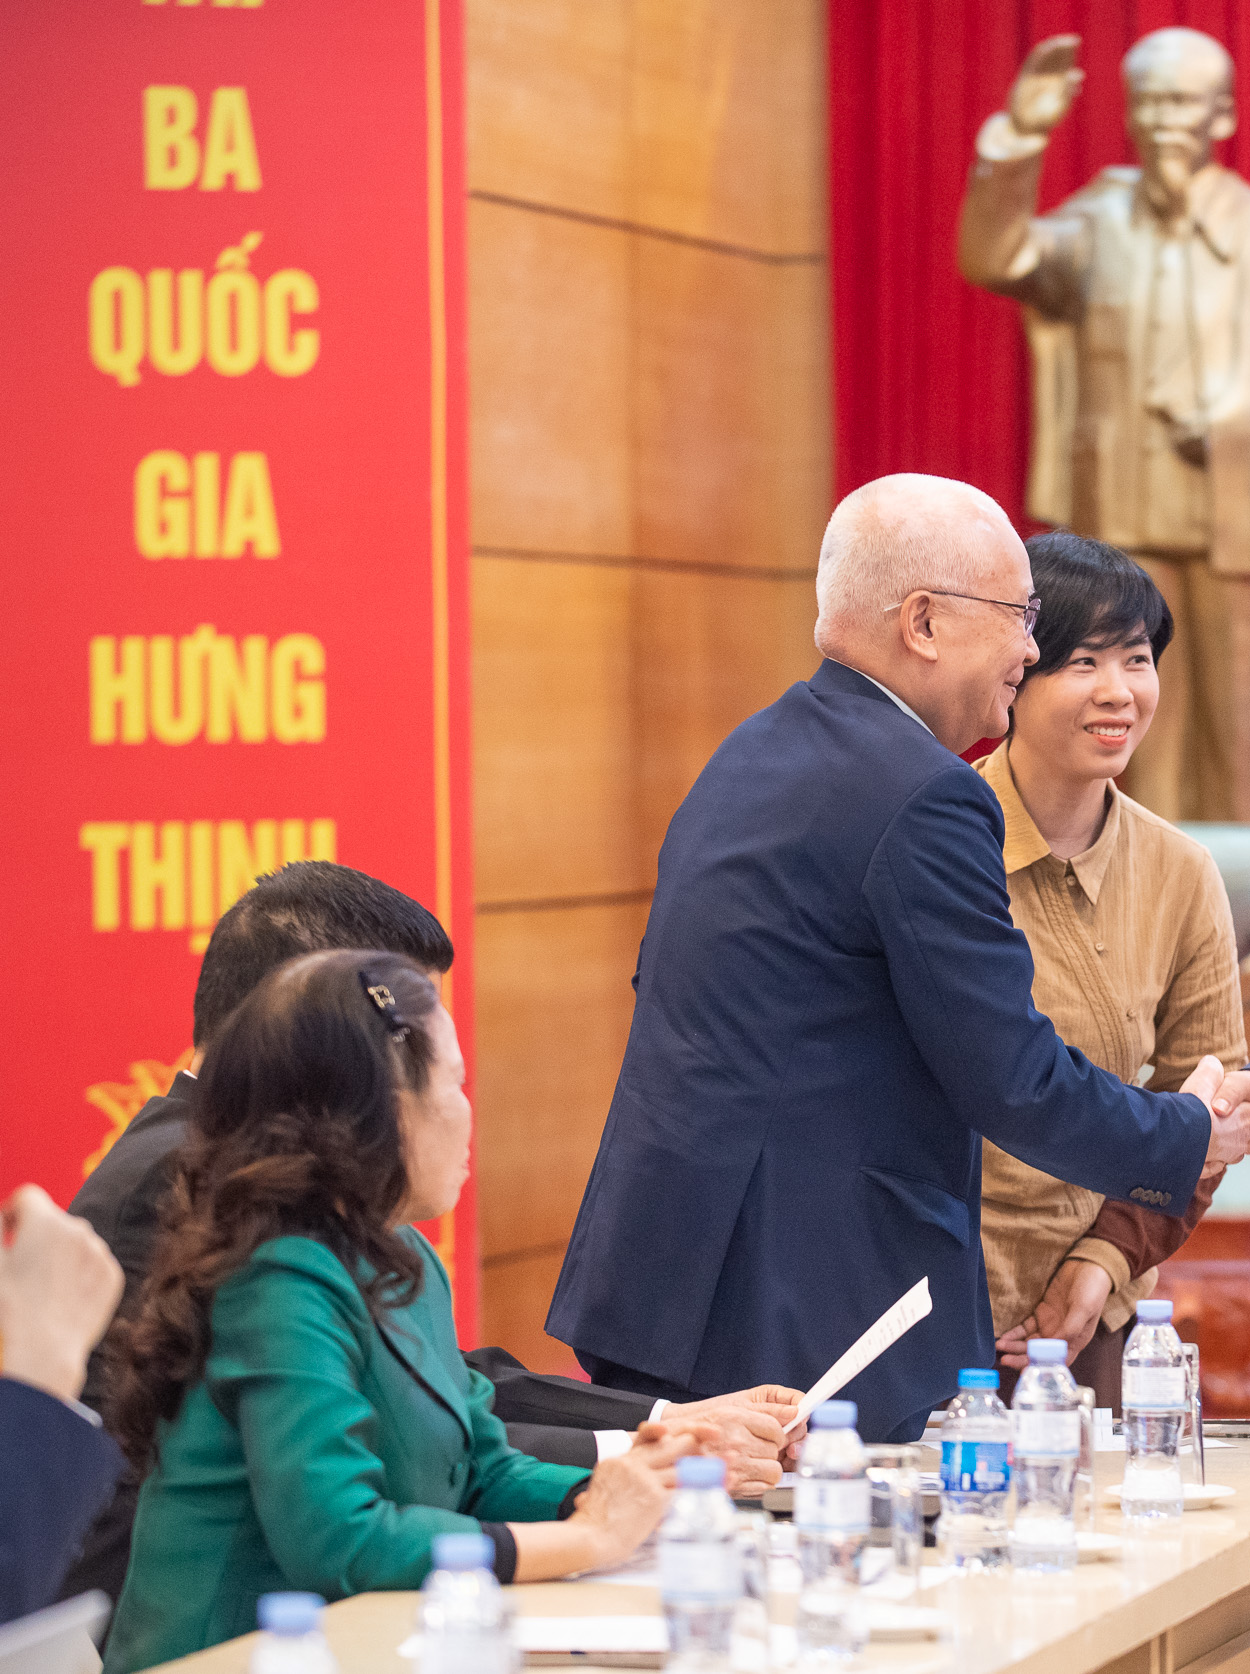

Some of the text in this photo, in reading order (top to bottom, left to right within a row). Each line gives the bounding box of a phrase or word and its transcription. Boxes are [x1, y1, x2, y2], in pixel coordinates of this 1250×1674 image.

[143, 84, 262, 192] BA
[89, 231, 321, 387] QUỐC
[134, 449, 281, 560] GIA
[90, 623, 327, 745] HƯNG
